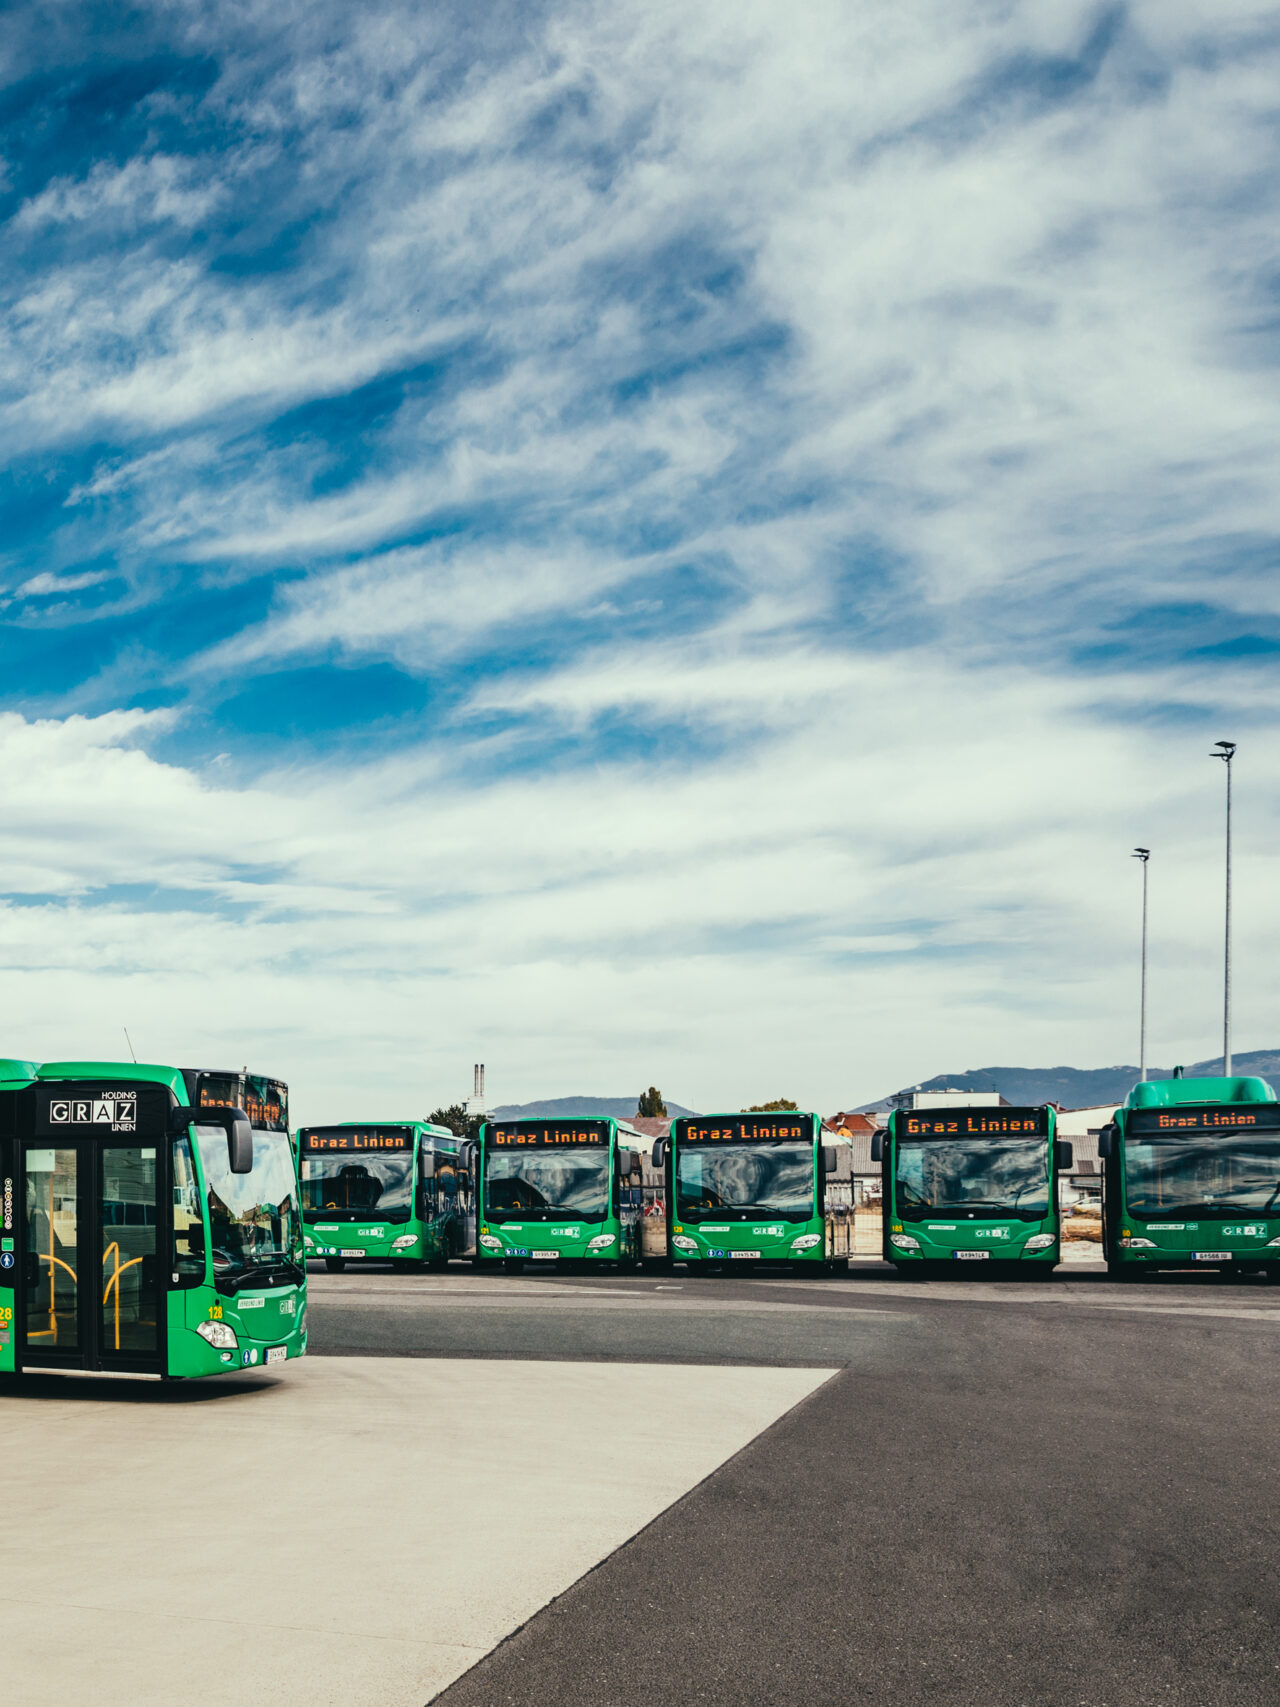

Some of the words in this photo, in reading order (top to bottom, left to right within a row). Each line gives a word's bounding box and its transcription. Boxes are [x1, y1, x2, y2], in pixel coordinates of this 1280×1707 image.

[101, 1091, 137, 1100] HOLDING
[52, 1102, 133, 1121] GRAZ
[907, 1118, 958, 1133] Graz
[967, 1117, 1036, 1132] Linien
[1158, 1114, 1197, 1127] Graz
[1202, 1112, 1256, 1126] Linien
[111, 1123, 136, 1131] LINIEN
[687, 1126, 732, 1140] Graz
[740, 1124, 802, 1138] Linien
[309, 1135, 348, 1148] Graz
[353, 1134, 404, 1148] Linien
[495, 1131, 537, 1144] Graz
[543, 1130, 599, 1143] Linien
[1223, 1227, 1265, 1235] GRAZ
[208, 1305, 223, 1320] 128
